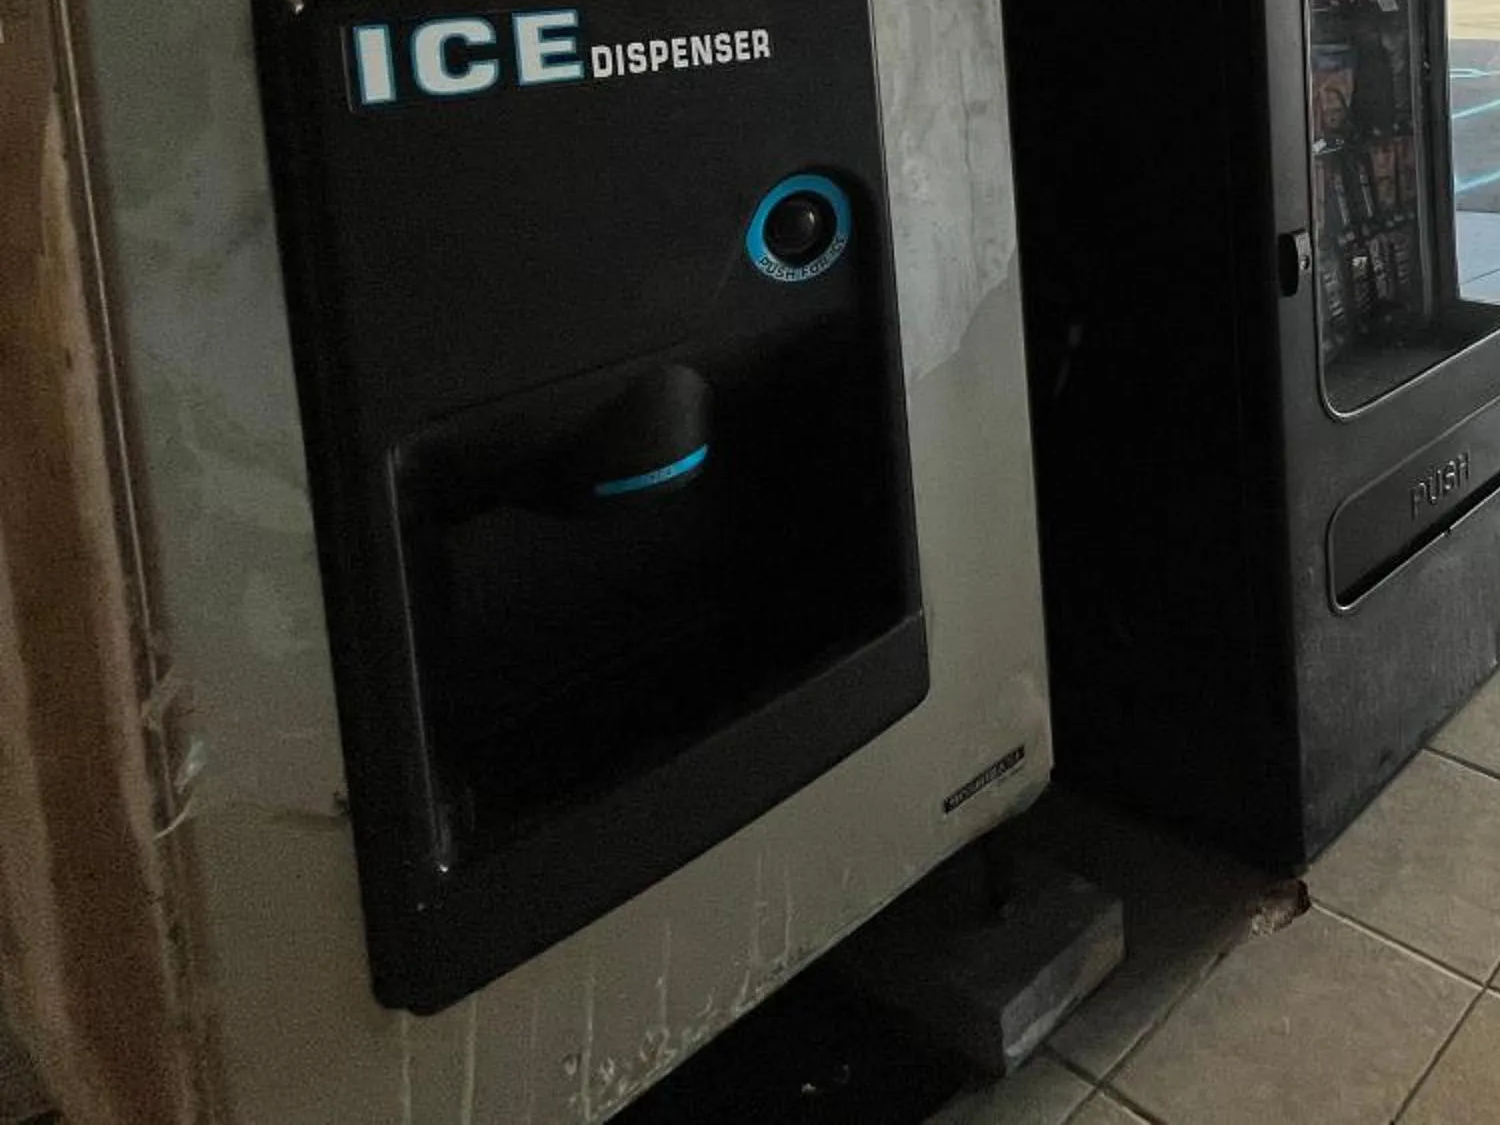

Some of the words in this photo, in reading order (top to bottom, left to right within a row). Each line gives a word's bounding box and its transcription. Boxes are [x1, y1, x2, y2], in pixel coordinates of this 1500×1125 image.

[353, 8, 585, 105] ICE
[590, 27, 771, 78] DISPENSER
[758, 255, 795, 280] PUSH
[801, 257, 828, 277] FOR
[1410, 452, 1471, 521] PUSH
